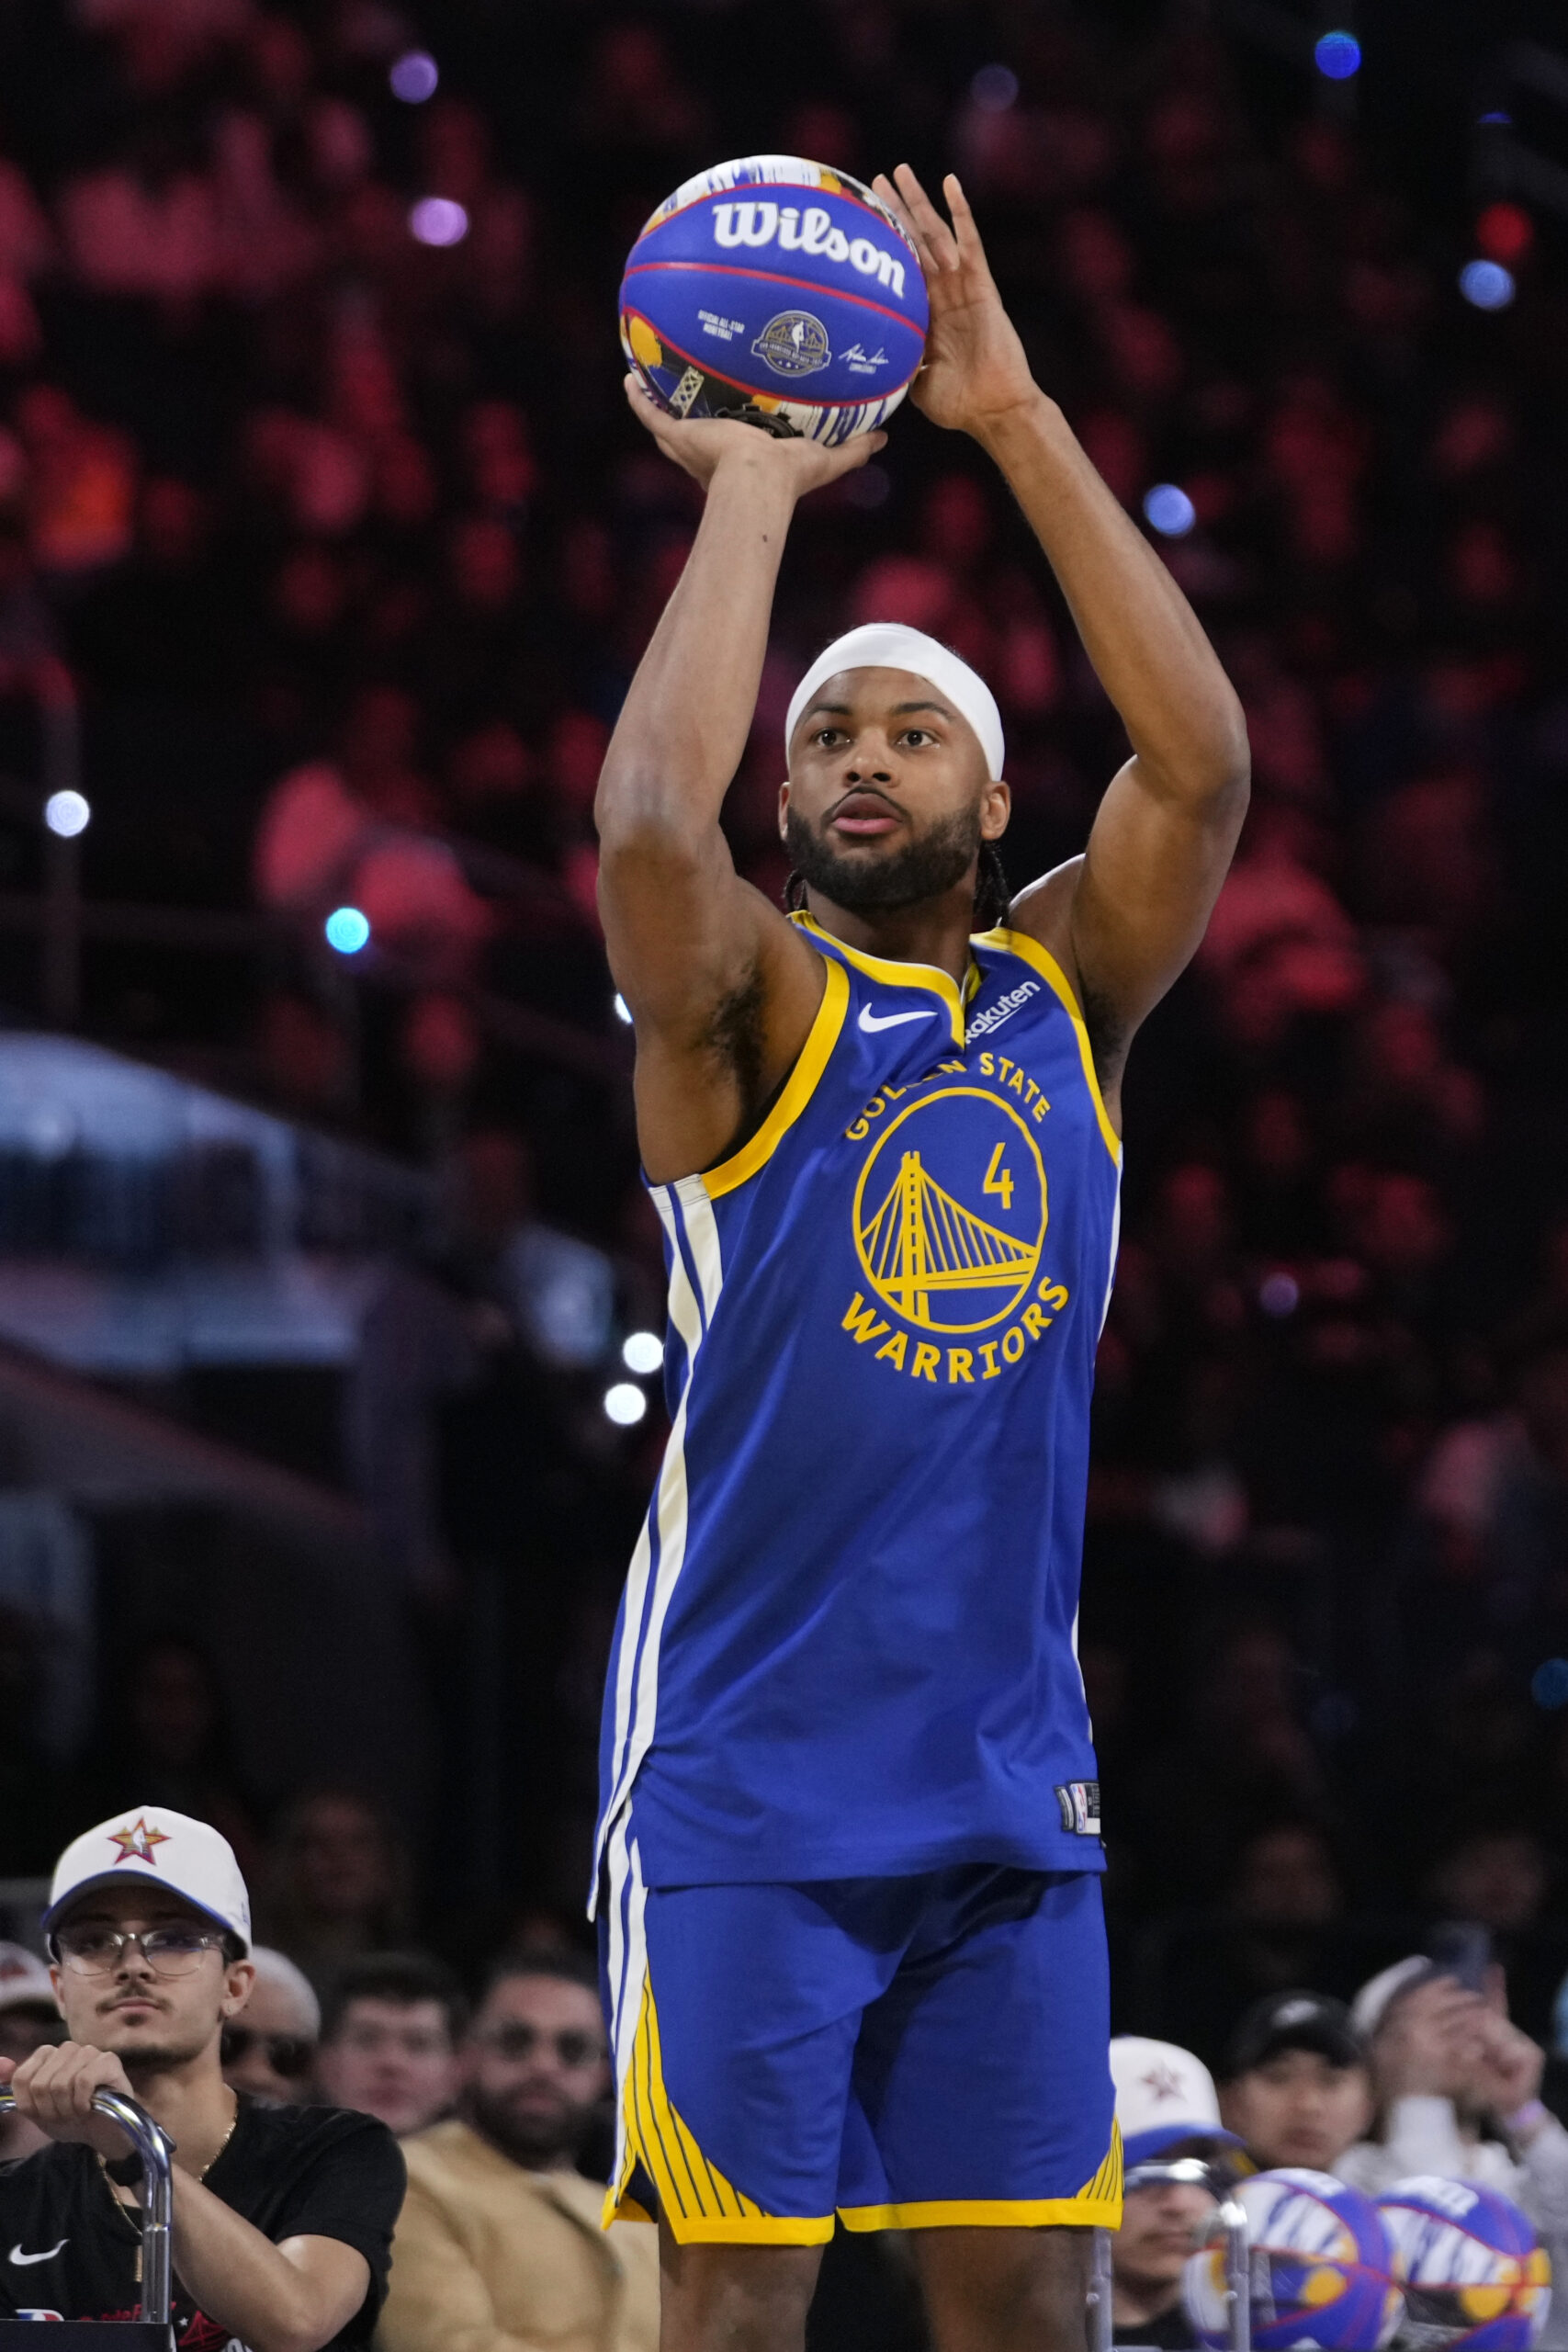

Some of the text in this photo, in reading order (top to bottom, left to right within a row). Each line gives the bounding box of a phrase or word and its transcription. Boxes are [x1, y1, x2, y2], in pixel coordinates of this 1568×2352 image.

[712, 201, 905, 299] Wilson
[979, 1052, 1051, 1123] STATE
[983, 1142, 1014, 1209] 4
[841, 1275, 1068, 1384] WARRIORS
